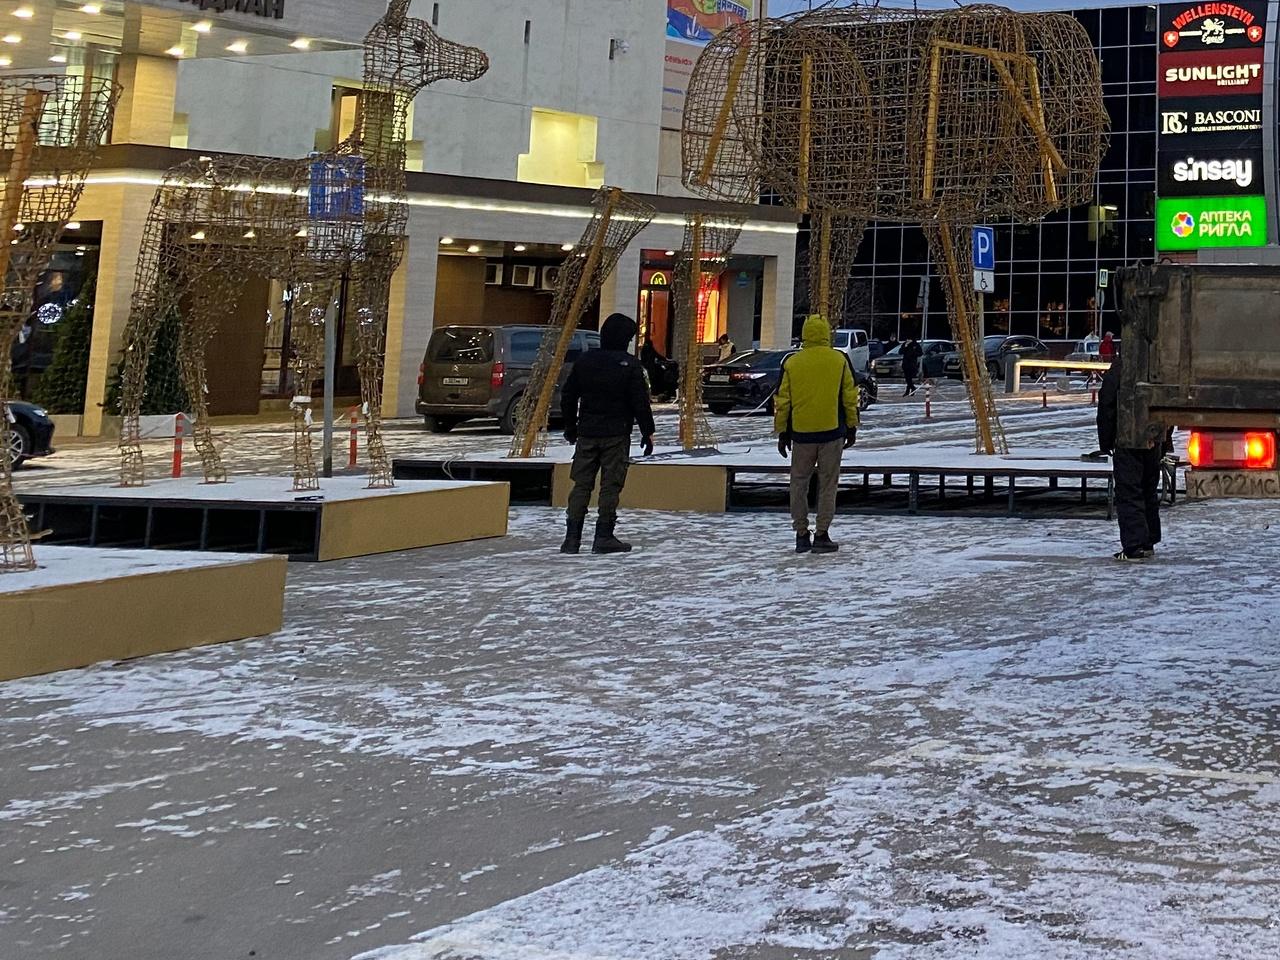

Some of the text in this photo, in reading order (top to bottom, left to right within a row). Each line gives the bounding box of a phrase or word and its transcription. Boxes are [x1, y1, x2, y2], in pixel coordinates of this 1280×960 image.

[1172, 3, 1255, 30] WELLENSTEYN
[1165, 64, 1261, 82] SUNLIGHT
[1194, 110, 1261, 125] BASCONI
[1173, 157, 1253, 187] sinsay
[1199, 210, 1252, 223] АПТЕКА
[1199, 222, 1252, 237] РИГЛА
[978, 231, 990, 264] P
